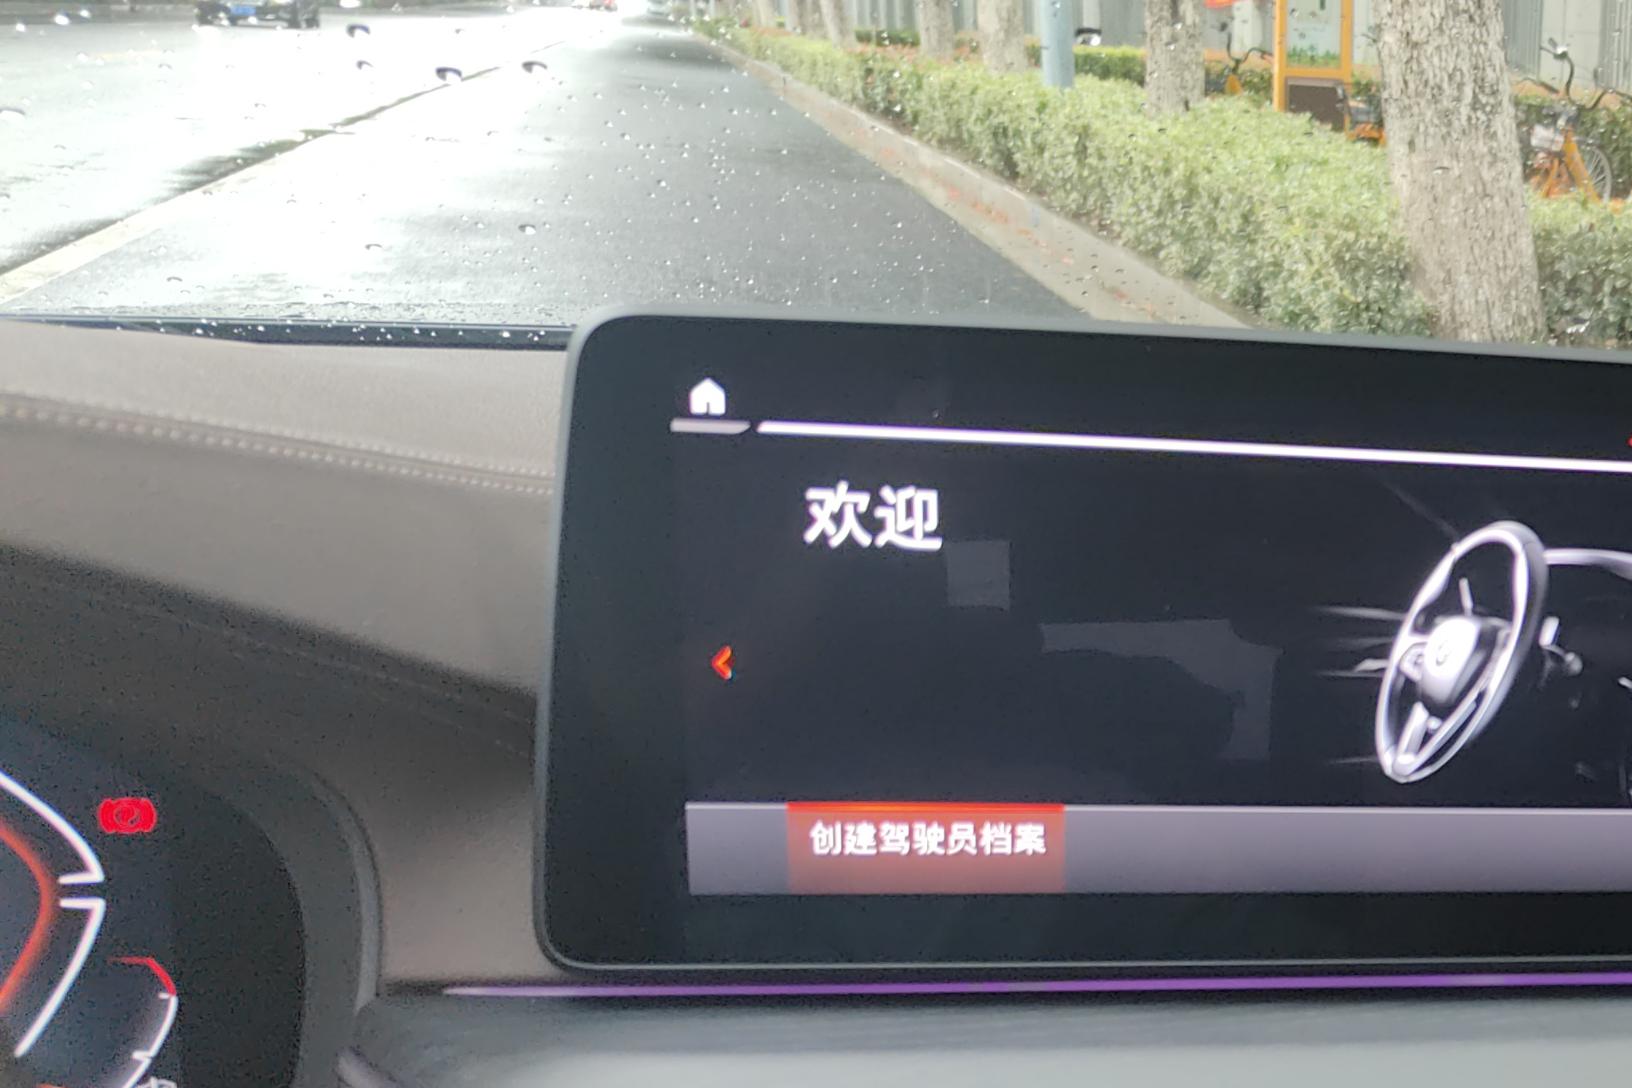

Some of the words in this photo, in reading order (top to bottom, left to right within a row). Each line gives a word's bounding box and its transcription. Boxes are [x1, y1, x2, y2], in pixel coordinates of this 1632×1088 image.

[803, 480, 943, 551] 欢迎
[809, 819, 1047, 856] 创建驾驶员档案
